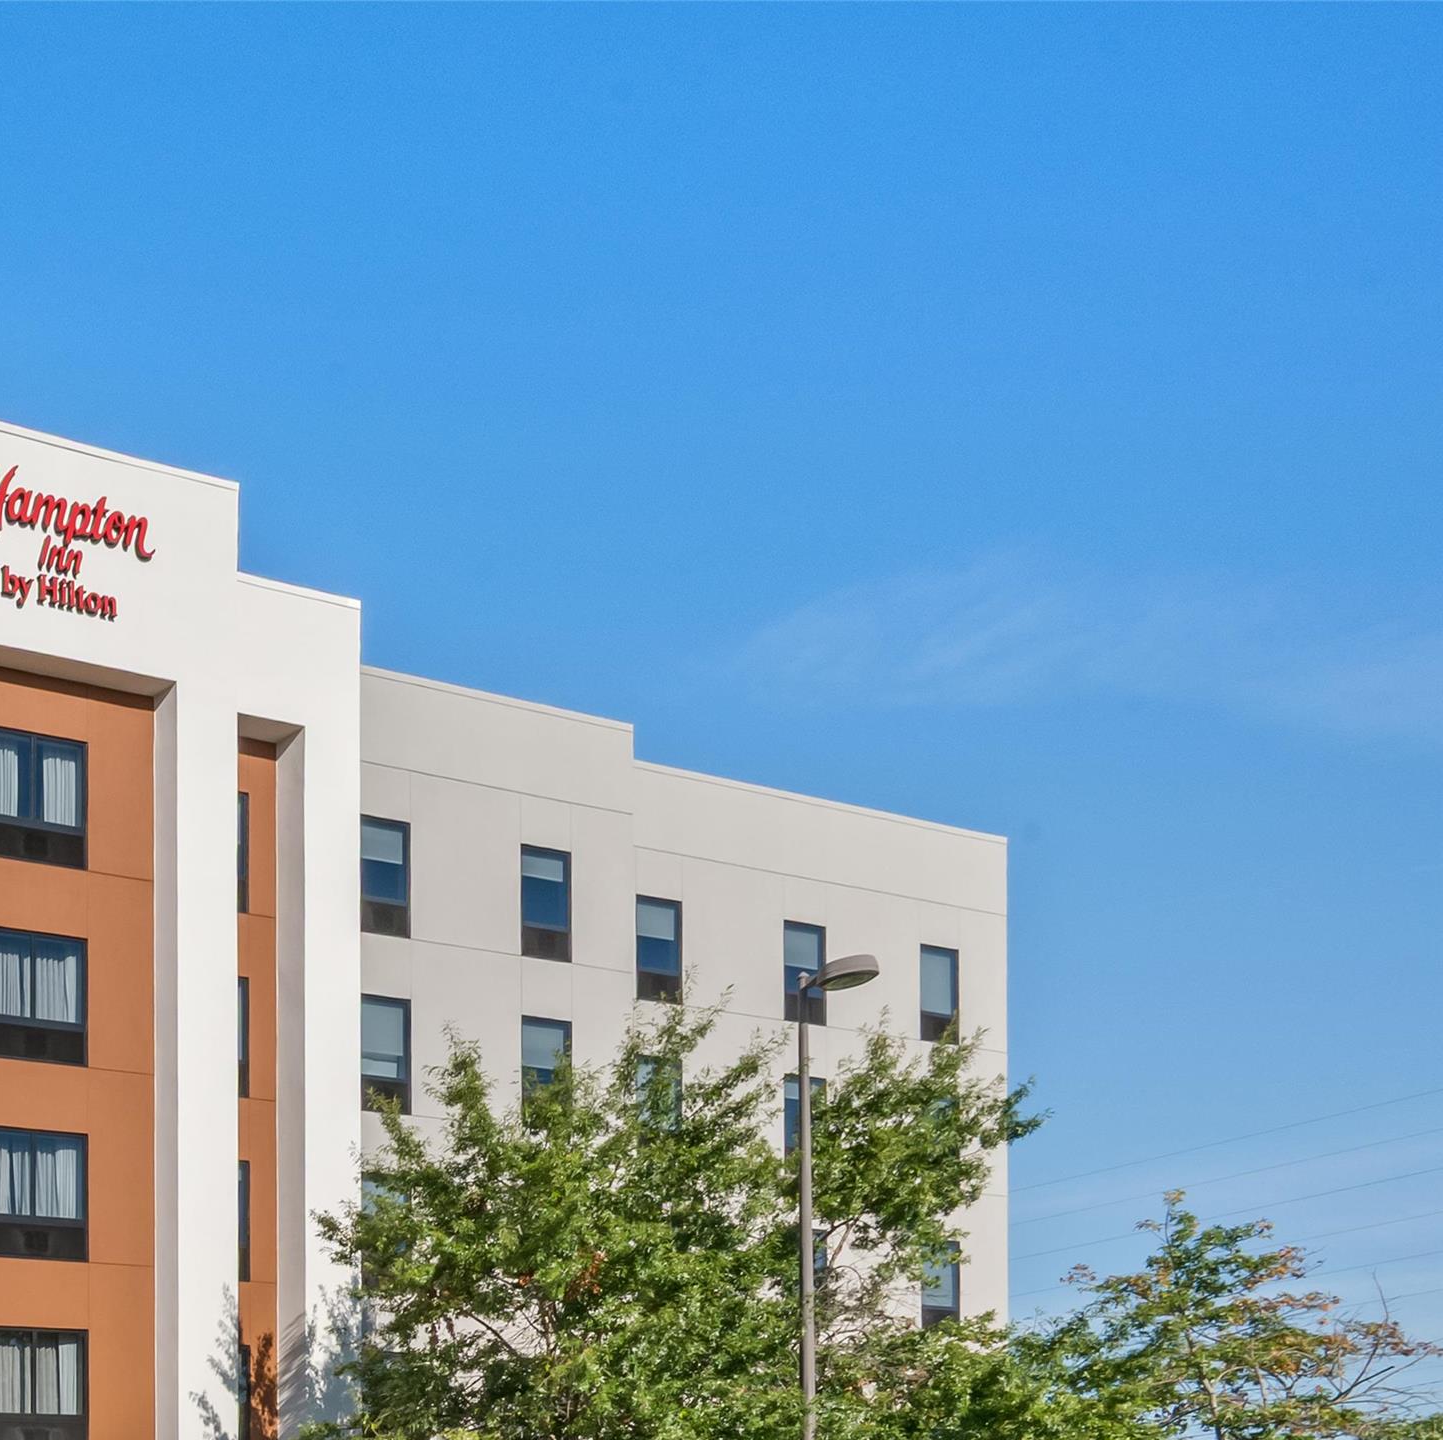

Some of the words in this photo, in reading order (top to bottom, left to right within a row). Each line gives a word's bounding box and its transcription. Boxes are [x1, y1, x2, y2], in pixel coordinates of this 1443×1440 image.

[38, 535, 83, 579] Inn
[1, 565, 33, 608] by
[37, 574, 118, 622] Hilton
